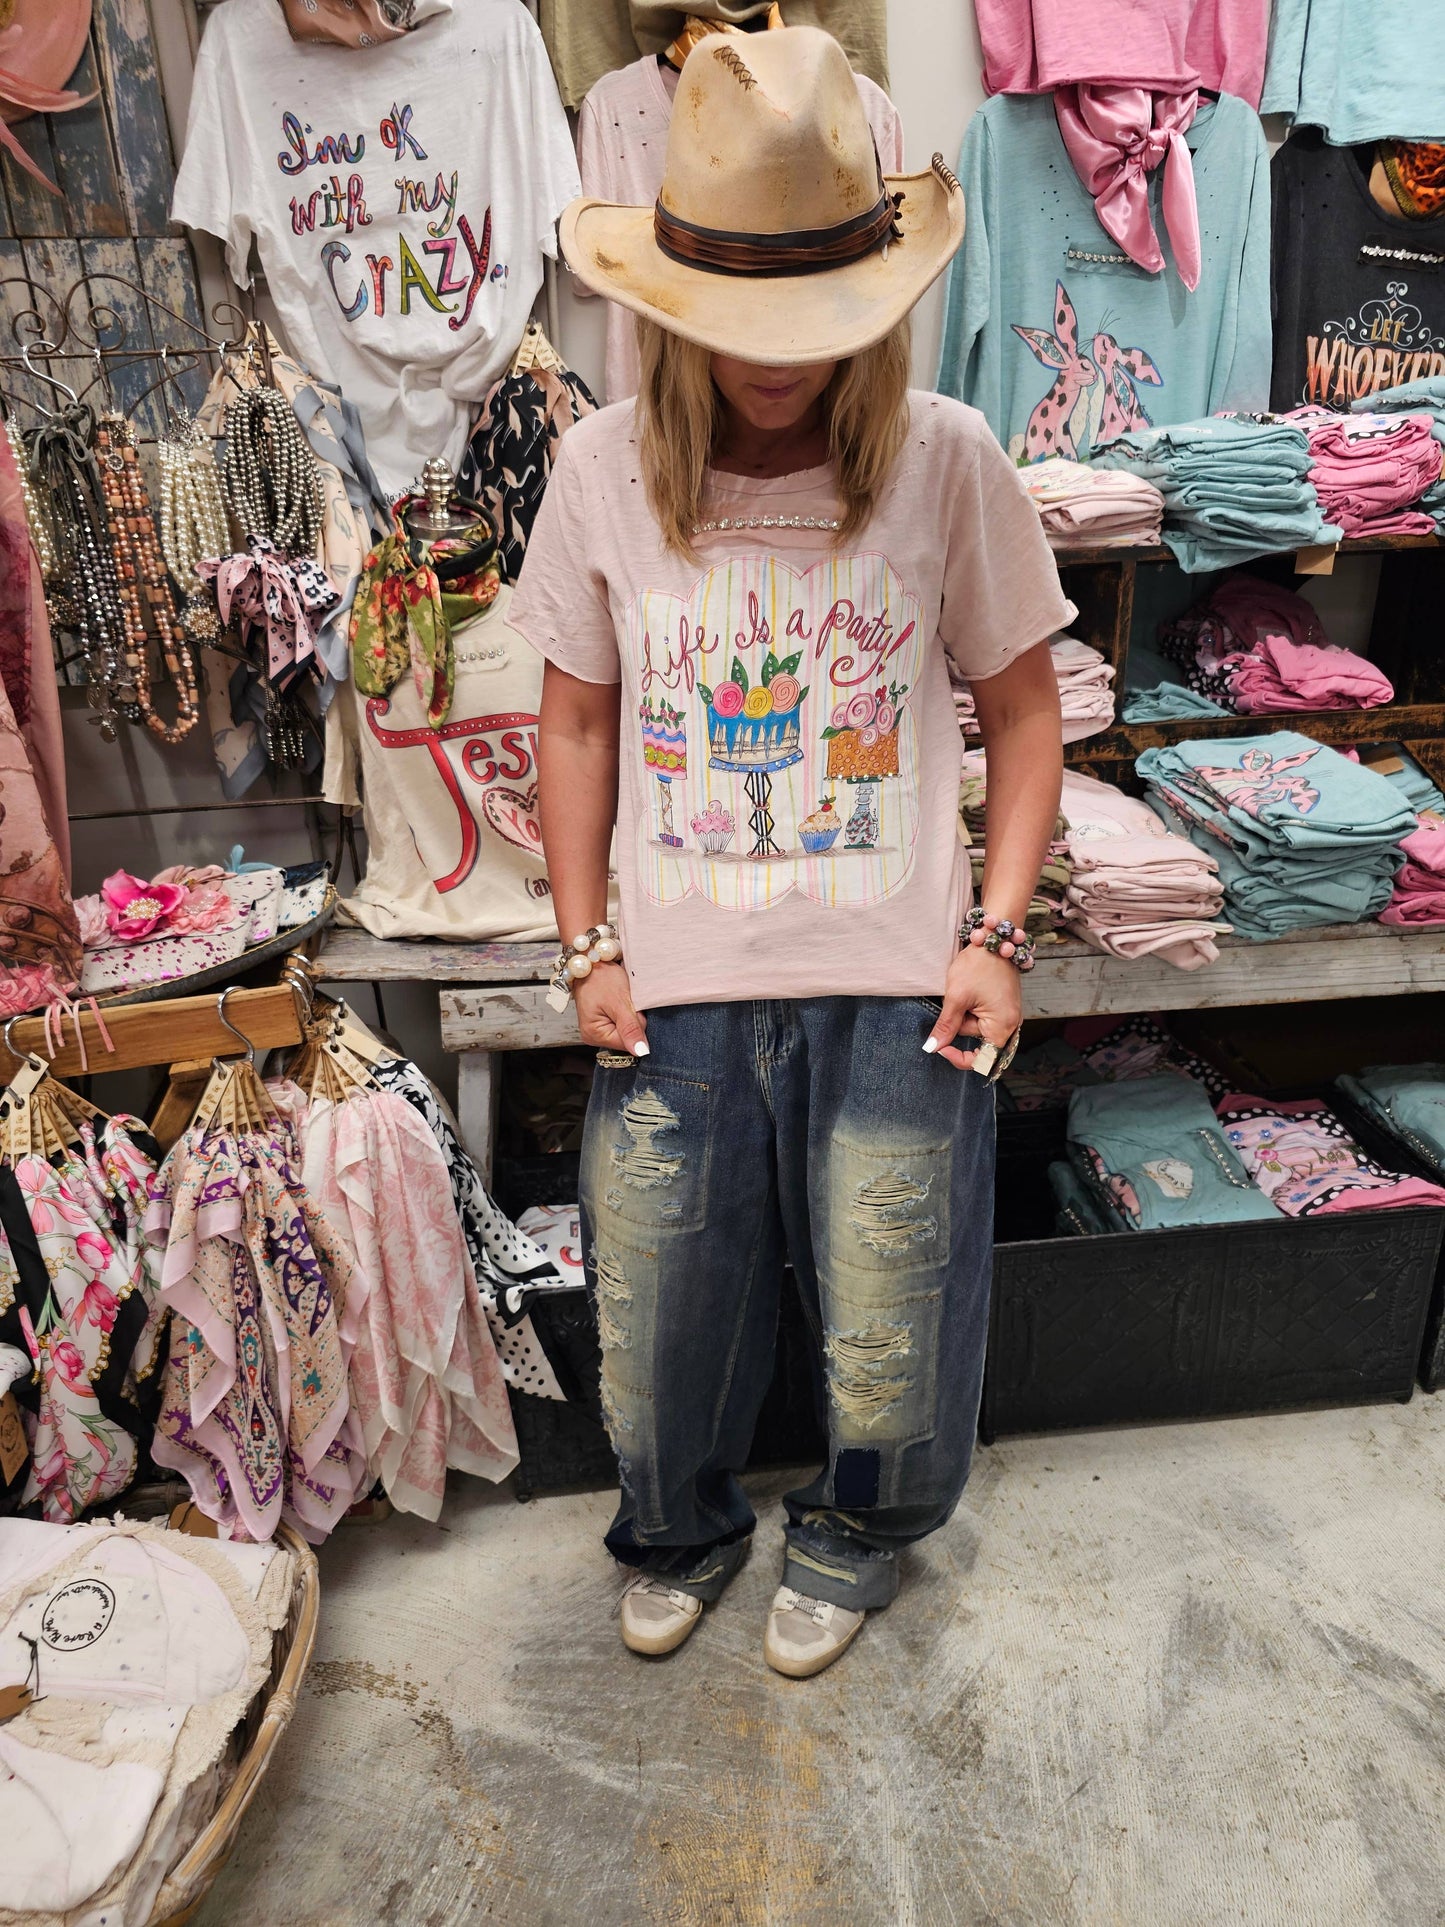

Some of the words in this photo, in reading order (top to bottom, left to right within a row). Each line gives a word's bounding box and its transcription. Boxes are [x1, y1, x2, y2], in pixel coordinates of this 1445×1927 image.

[289, 173, 373, 236] with
[394, 170, 458, 238] my
[1371, 318, 1406, 344] LET
[641, 614, 719, 694] Life
[734, 590, 774, 650] Is
[785, 607, 812, 641] a
